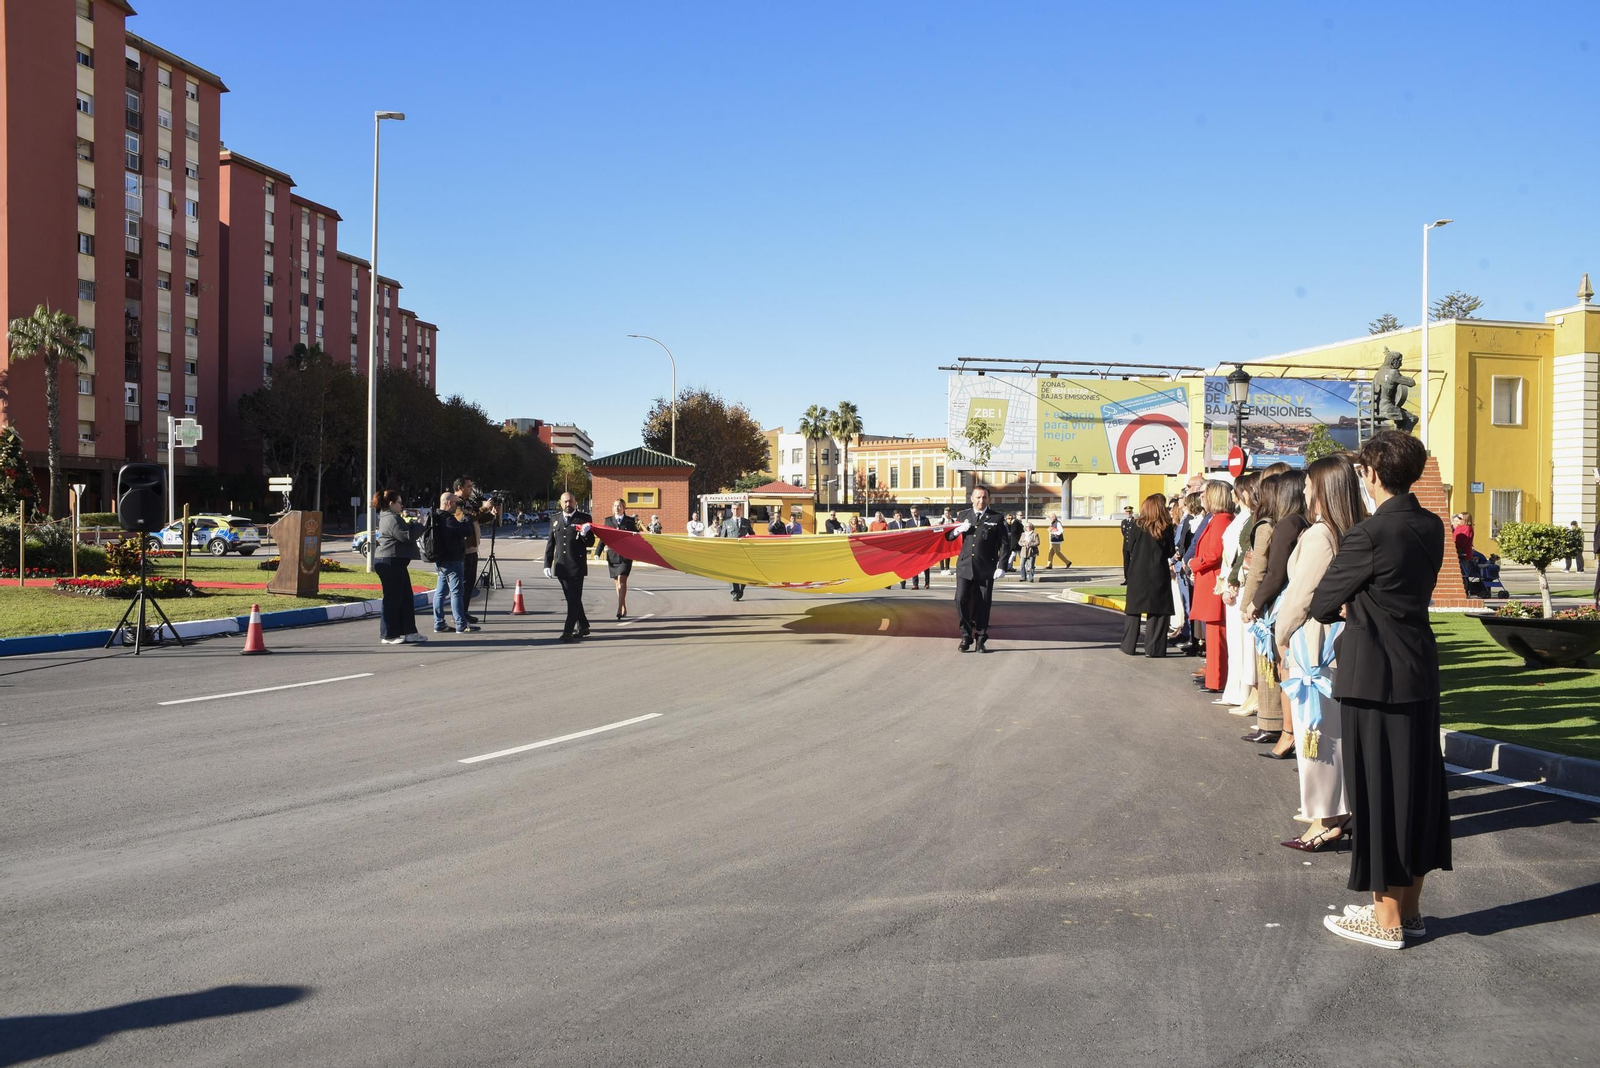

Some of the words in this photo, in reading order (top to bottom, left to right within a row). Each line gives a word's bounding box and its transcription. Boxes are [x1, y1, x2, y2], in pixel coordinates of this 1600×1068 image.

[1205, 393, 1220, 404] DE
[1254, 394, 1292, 405] ESTAR
[1295, 395, 1305, 405] Y
[974, 408, 995, 418] ZBE
[1053, 410, 1095, 422] espacio
[1249, 406, 1312, 418] EMISIONES
[1044, 421, 1068, 430] para
[1071, 420, 1096, 430] vivir
[1107, 418, 1125, 429] ZBE
[1043, 430, 1077, 442] mejor
